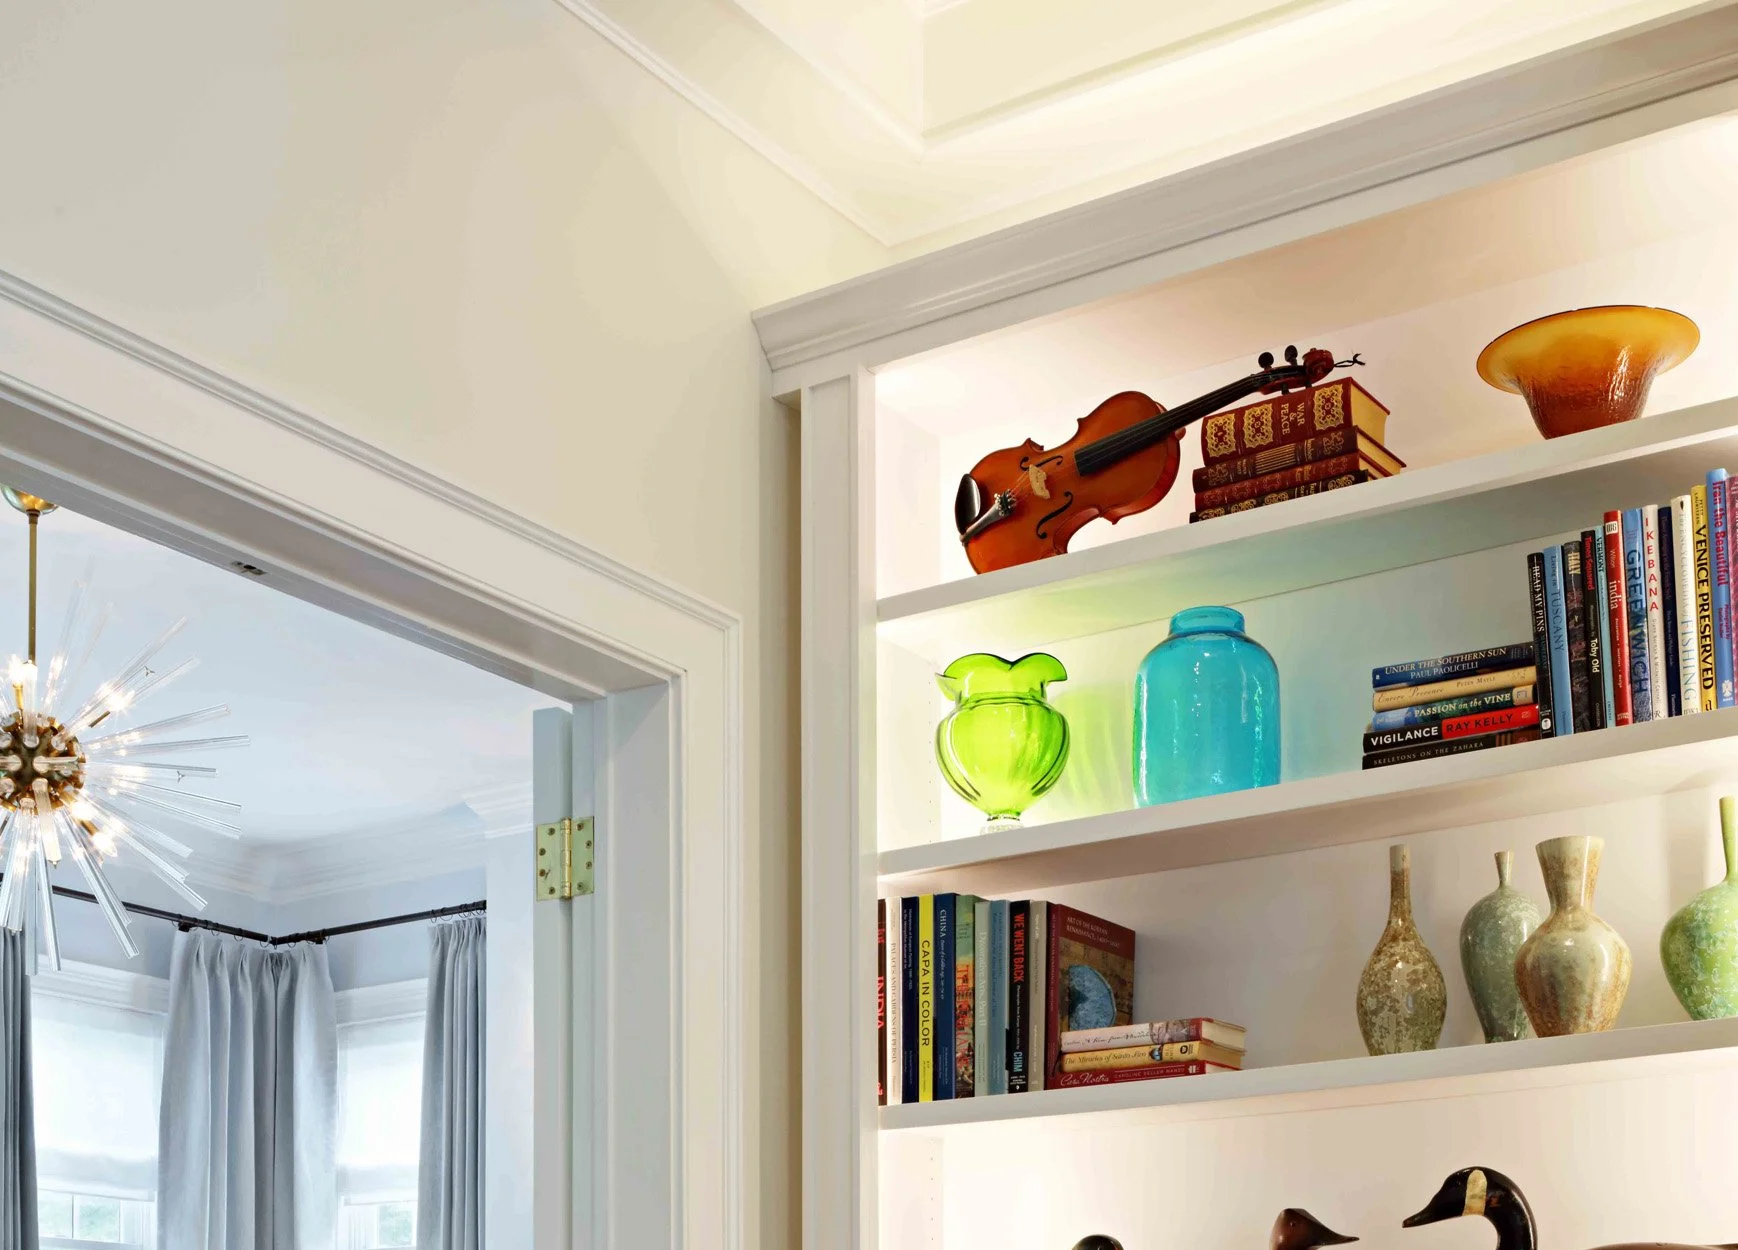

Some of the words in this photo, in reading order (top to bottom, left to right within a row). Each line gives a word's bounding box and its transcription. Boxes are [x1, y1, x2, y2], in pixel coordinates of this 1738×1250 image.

[1280, 403, 1290, 435] PEACE
[1290, 412, 1297, 422] &
[1297, 402, 1305, 426] WAR
[1713, 481, 1723, 505] Iran
[1714, 508, 1725, 528] the
[1567, 551, 1581, 575] ITALY
[1596, 537, 1604, 573] VERMONT
[1645, 517, 1659, 611] IKEBANA
[1695, 524, 1710, 590] VENICE
[1715, 531, 1729, 586] Beautiful
[1532, 565, 1542, 592] READ
[1534, 593, 1543, 607] MY
[1609, 580, 1622, 610] india
[1536, 610, 1545, 632] PINS
[1551, 591, 1565, 652] TUSCANY
[1626, 549, 1649, 694] GREENWICH
[1590, 638, 1598, 657] Toby
[1698, 591, 1714, 690] PRESERVED
[1385, 664, 1416, 675] UNDER
[1419, 660, 1435, 669] THE
[1437, 650, 1485, 666] SOUTHERN
[1487, 648, 1507, 657] SUN
[1411, 670, 1432, 679] PAUL
[1433, 661, 1479, 675] PAOLICELLI
[1591, 659, 1600, 673] Old
[1681, 619, 1697, 701] FISHING
[1415, 702, 1457, 717] PASSION
[1470, 698, 1482, 707] the
[1484, 693, 1511, 705] VINE
[1446, 721, 1469, 732] RAY
[1475, 714, 1513, 728] KELLY
[1371, 726, 1439, 746] VIGILANCE
[1014, 914, 1025, 929] WE
[1014, 930, 1024, 956] WENT
[921, 940, 931, 977] CAPA
[1013, 957, 1024, 983] BACK
[921, 982, 931, 996] IN
[921, 1000, 931, 1047] COLOR
[1013, 1051, 1023, 1072] CHIM
[1080, 1072, 1109, 1085] Nostra
